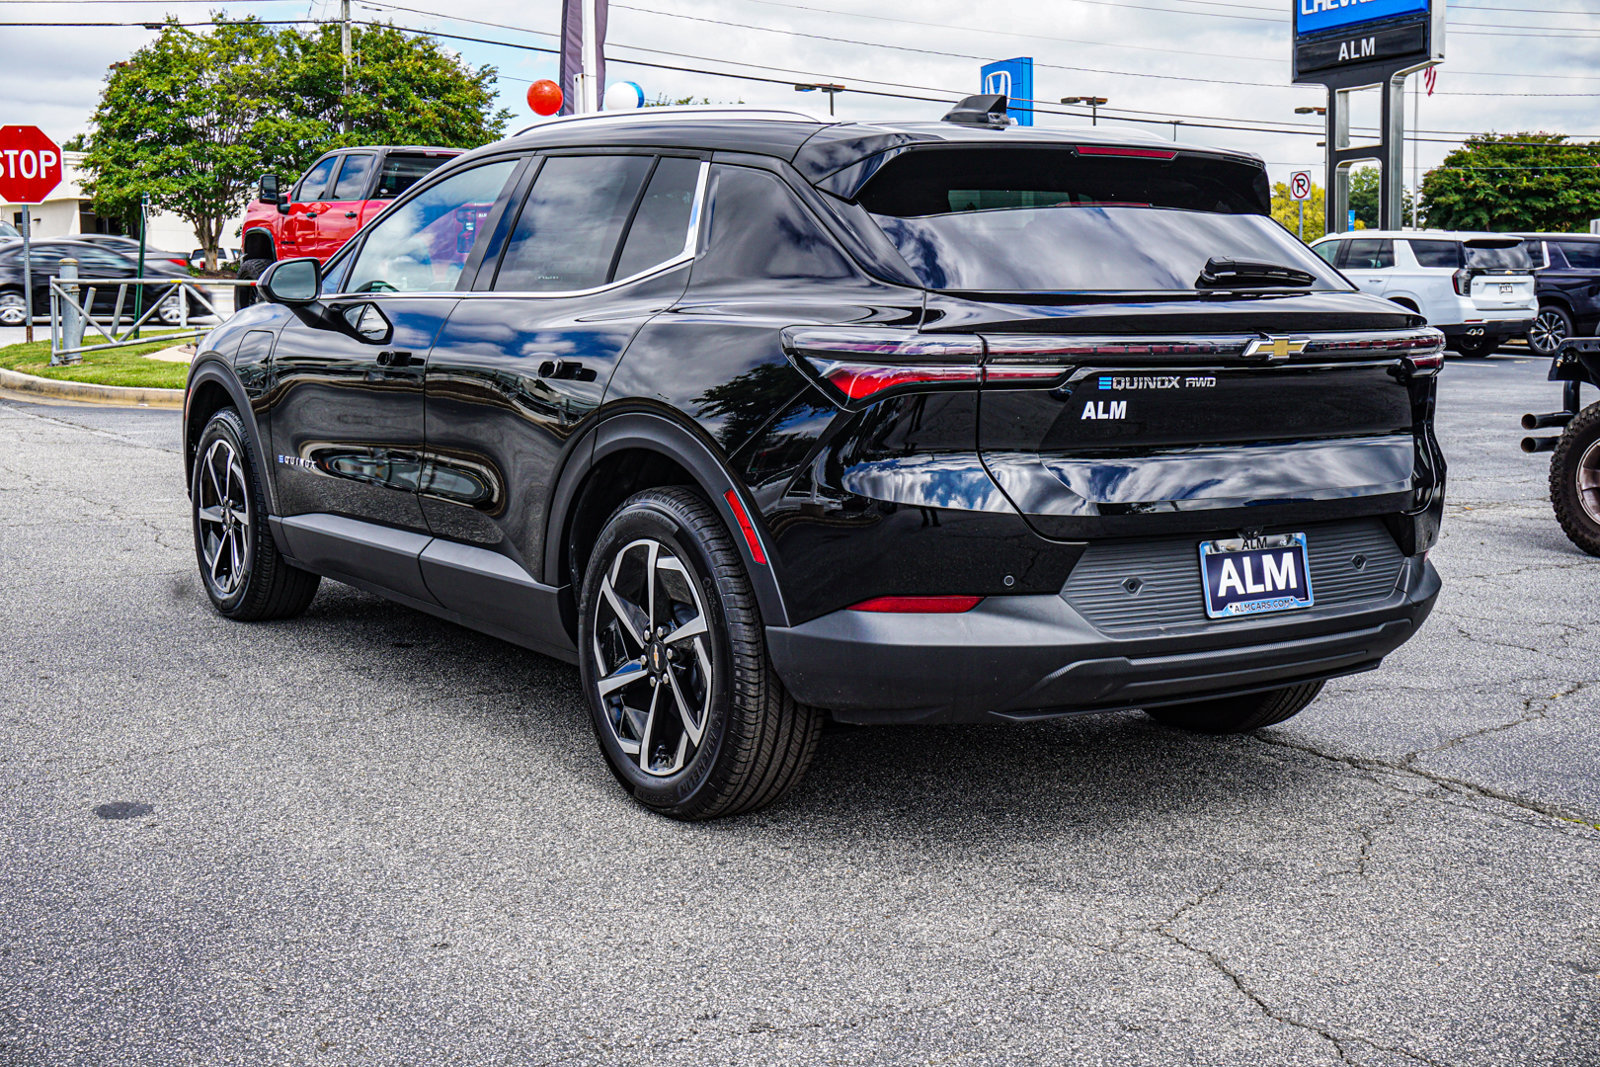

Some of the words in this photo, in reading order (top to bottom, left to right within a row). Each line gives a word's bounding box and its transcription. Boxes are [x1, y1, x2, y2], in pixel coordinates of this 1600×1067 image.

[1338, 36, 1376, 61] ALM
[0, 149, 57, 179] TOP
[1098, 376, 1180, 390] EQUINOX
[1081, 400, 1127, 420] ALM
[278, 454, 317, 469] EQUINOX
[1242, 537, 1267, 550] ALM
[1217, 551, 1298, 597] ALM
[1234, 599, 1290, 613] ALMCARS.COM
